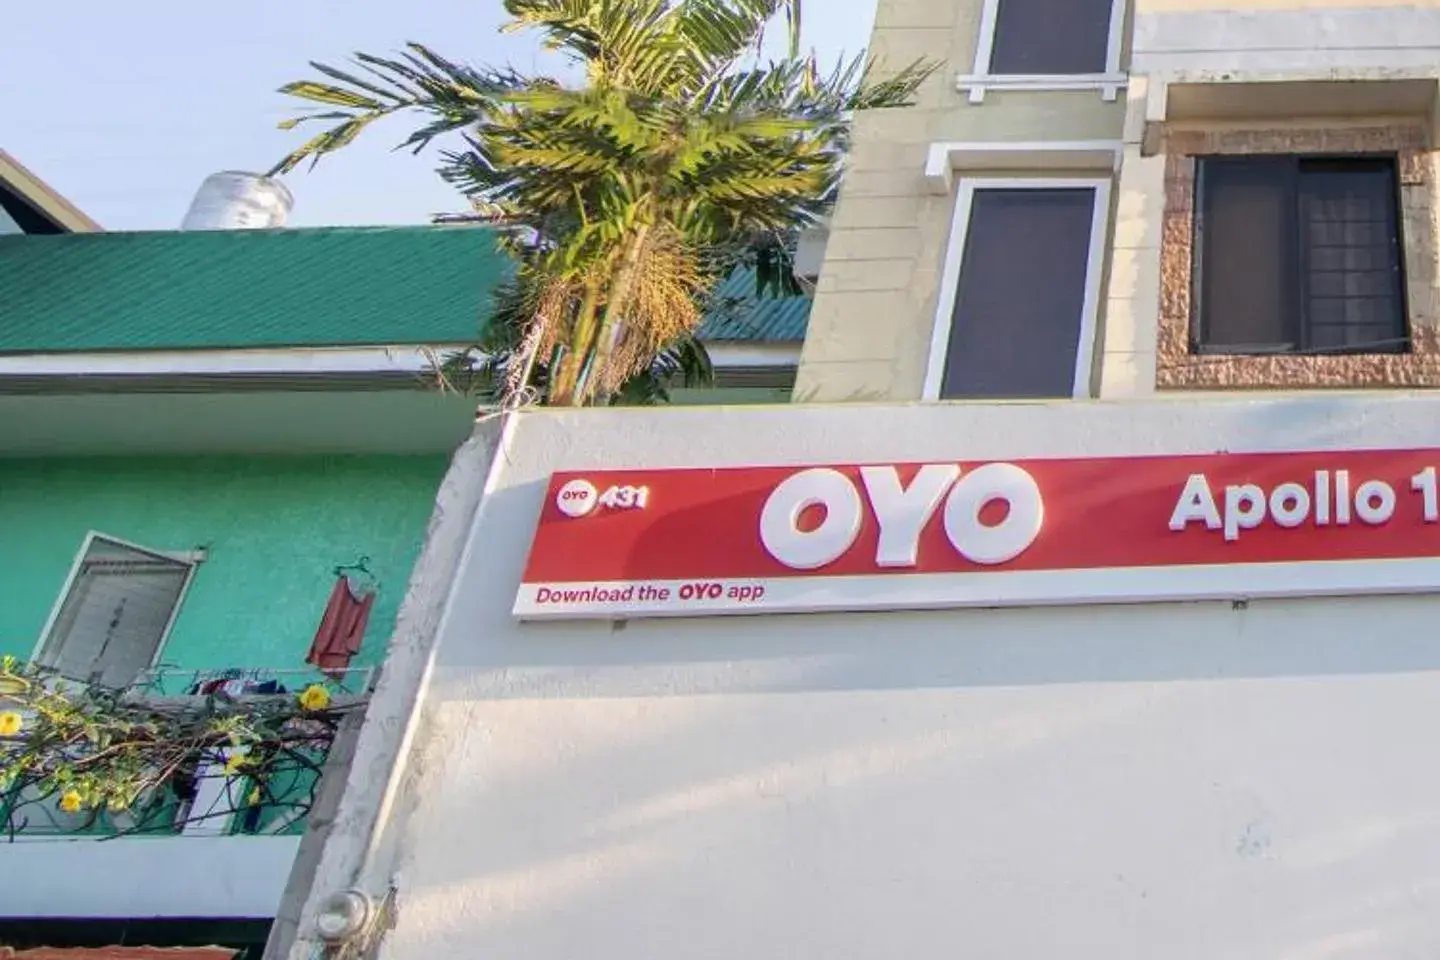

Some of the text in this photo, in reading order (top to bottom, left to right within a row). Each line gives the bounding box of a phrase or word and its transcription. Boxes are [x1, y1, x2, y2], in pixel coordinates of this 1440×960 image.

[562, 484, 649, 509] OYO 431
[759, 462, 1044, 569] OYO
[1168, 470, 1396, 541] Apollo
[536, 583, 765, 604] Download the OYO app
